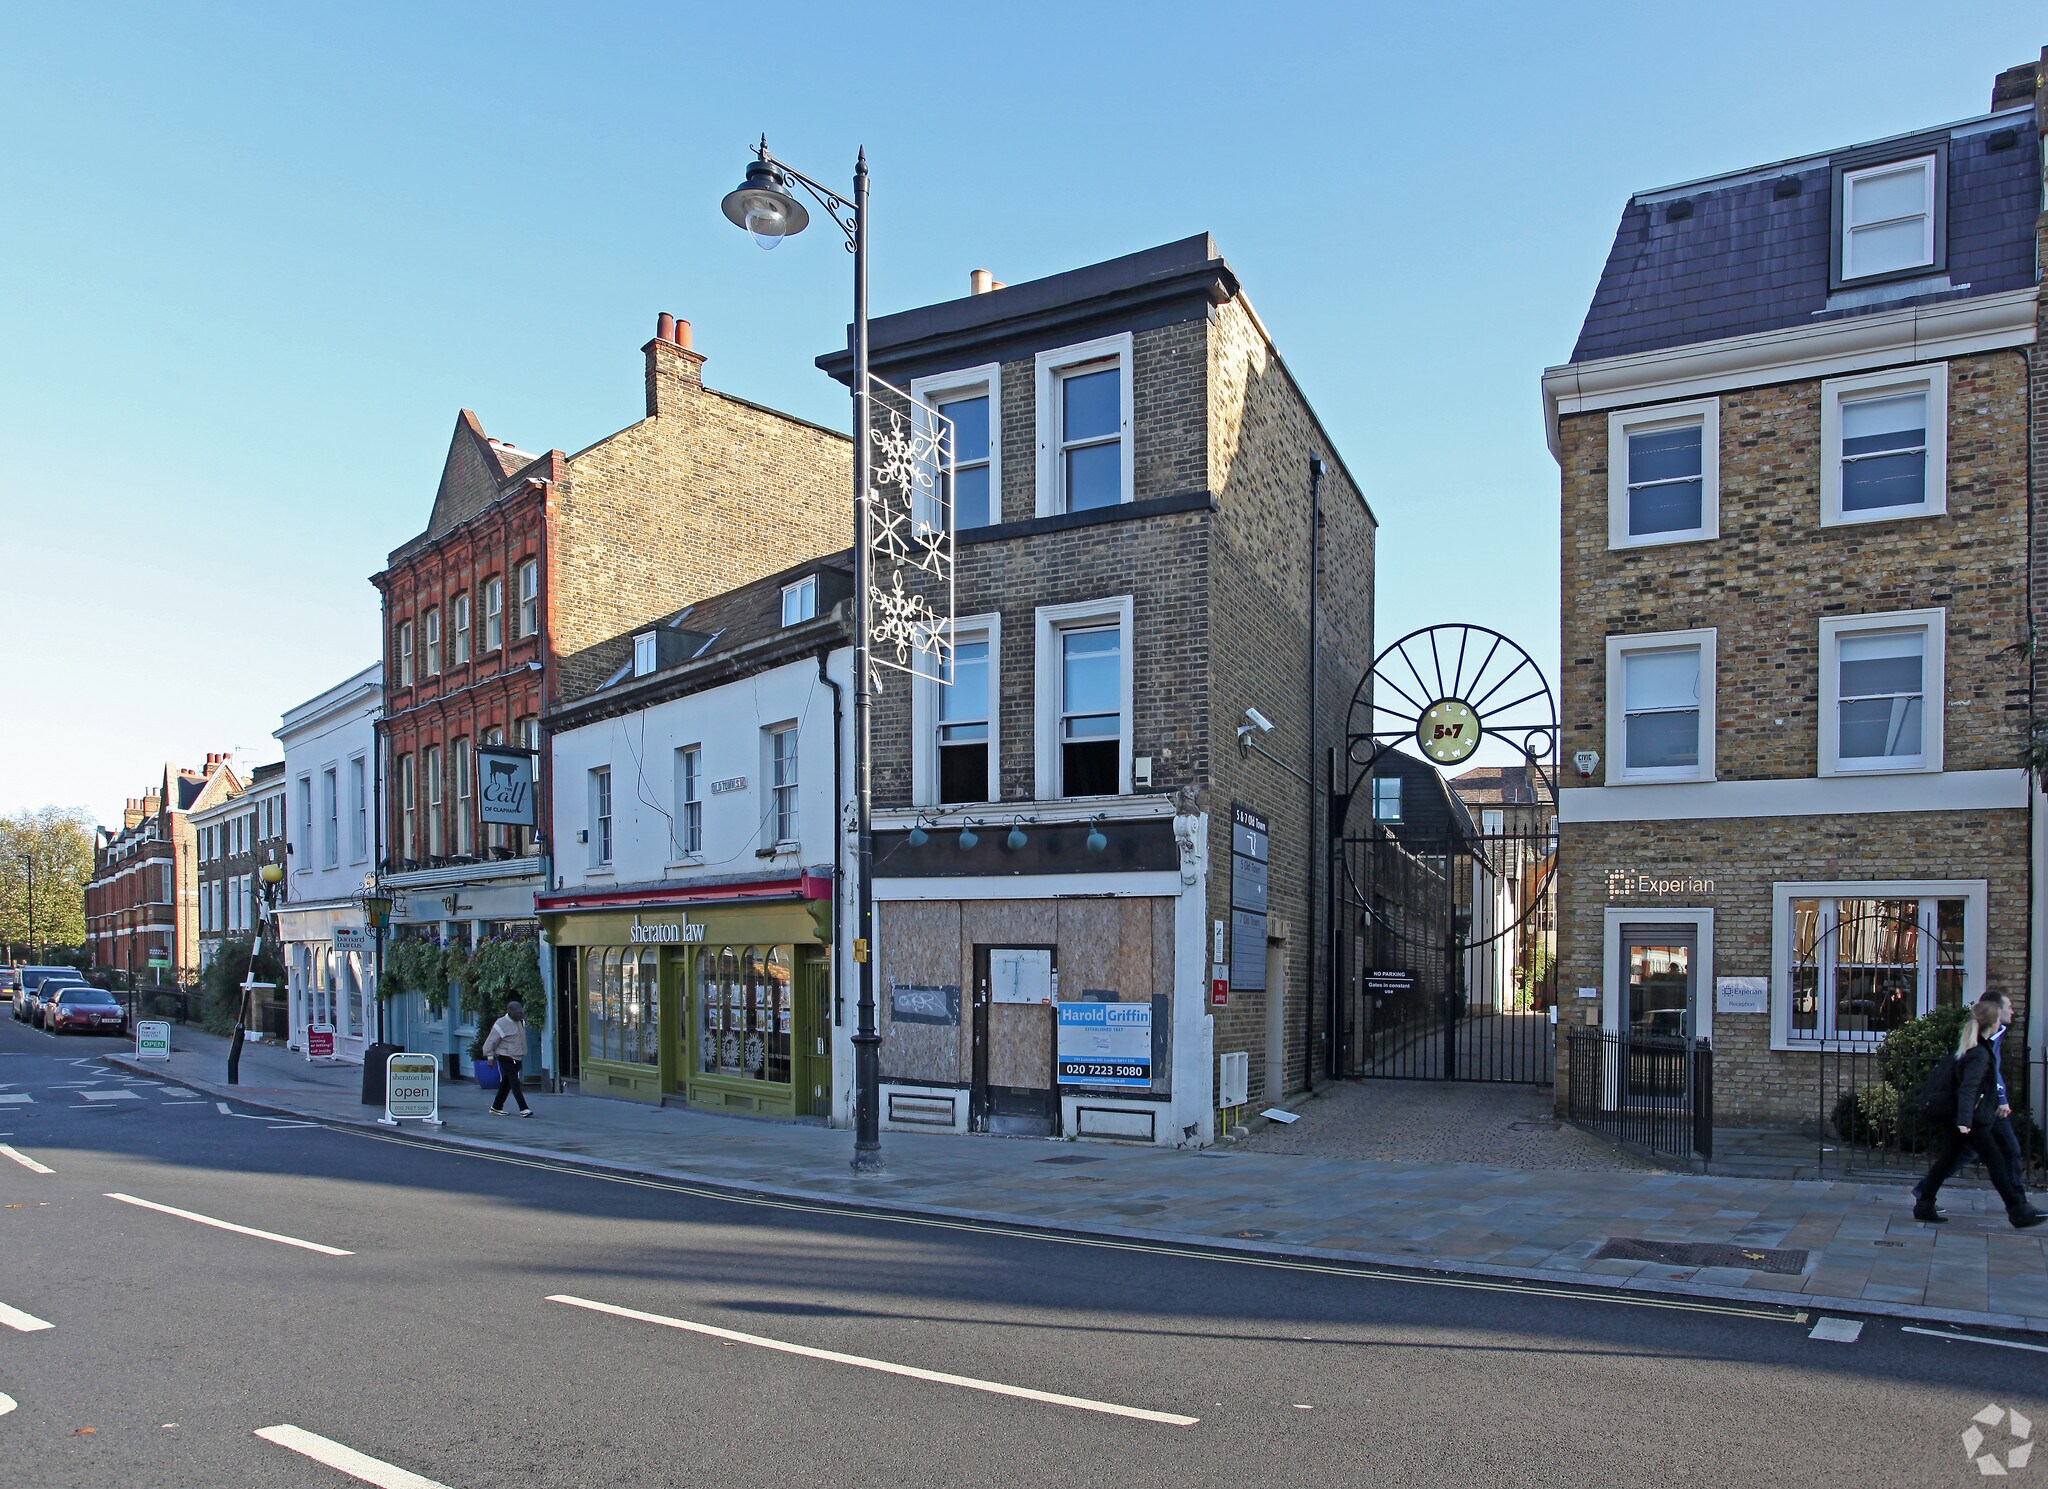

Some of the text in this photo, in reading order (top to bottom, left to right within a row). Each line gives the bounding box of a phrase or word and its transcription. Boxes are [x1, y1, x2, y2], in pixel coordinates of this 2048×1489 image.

[484, 781, 527, 813] Calf
[1236, 809, 1240, 821] 5
[1244, 812, 1248, 824] 7
[1247, 814, 1255, 827] Old
[1255, 817, 1266, 832] Town
[1251, 862, 1261, 874] Town
[1639, 875, 1715, 896] Experian
[630, 911, 706, 943] sheraton law
[337, 935, 365, 943] barnard
[1734, 987, 1763, 996] Experian
[1062, 1009, 1149, 1022] Harold Griffin
[143, 1040, 164, 1048] OPEN
[392, 1073, 420, 1081] sheraton
[1066, 1064, 1143, 1077] 020 7223 5080
[395, 1087, 429, 1100] open
